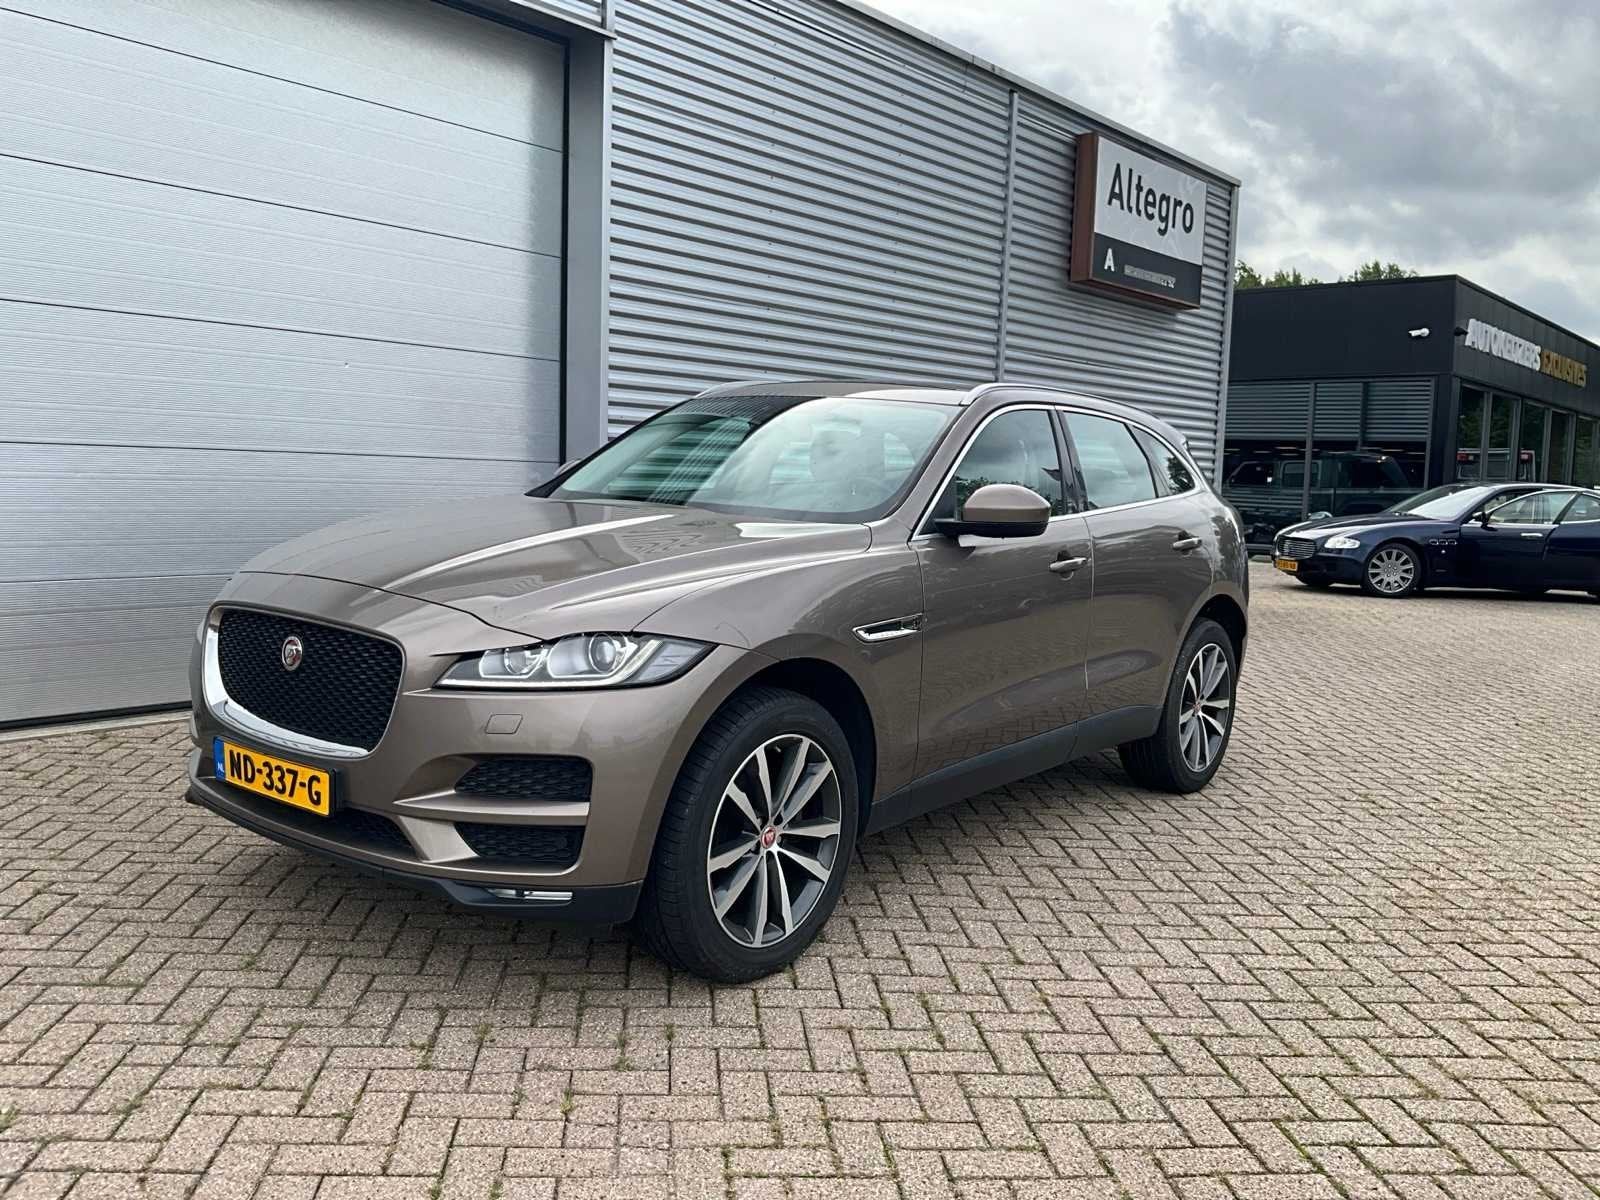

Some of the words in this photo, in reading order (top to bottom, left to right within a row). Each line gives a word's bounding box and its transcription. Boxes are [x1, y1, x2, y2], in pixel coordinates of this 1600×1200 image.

[1107, 162, 1194, 237] Altegro
[1104, 248, 1115, 272] A
[229, 749, 322, 806] ND-337-G
